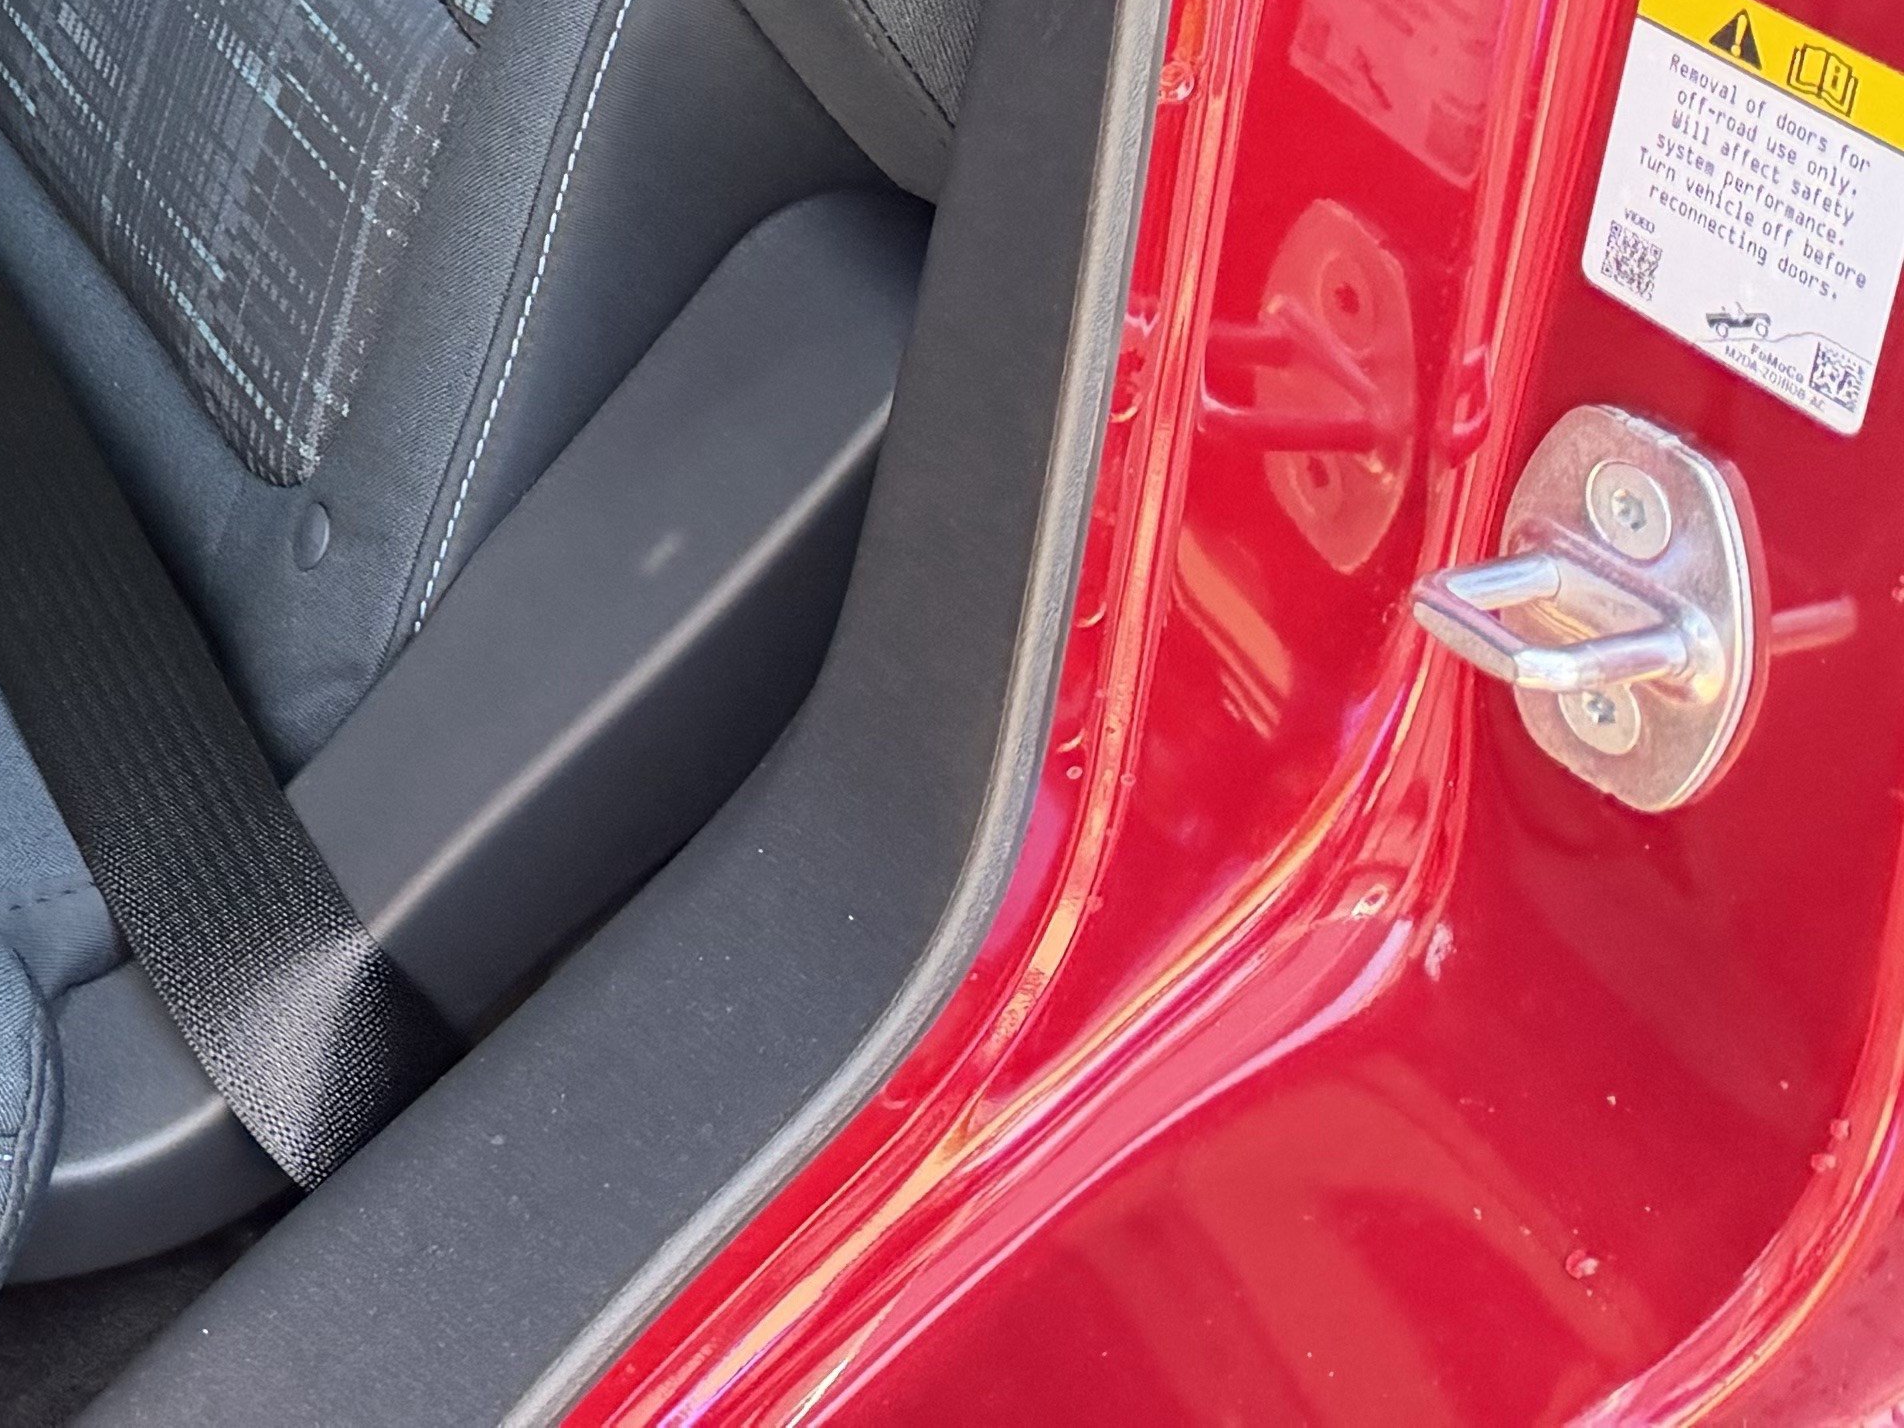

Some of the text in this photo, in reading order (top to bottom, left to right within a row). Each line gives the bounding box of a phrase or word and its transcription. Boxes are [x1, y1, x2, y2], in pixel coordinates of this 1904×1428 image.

[1670, 53, 1871, 173] Removal of doors for
[1671, 108, 1855, 227] Will affect safety
[1678, 89, 1857, 197] off-road use only.
[1624, 207, 1655, 234] VIDEO
[1640, 146, 1867, 289] Turn vehicle off before
[1649, 184, 1838, 300] reconnecting doors.
[1657, 133, 1845, 246] system performance.
[1750, 343, 1805, 383] FoMoCo
